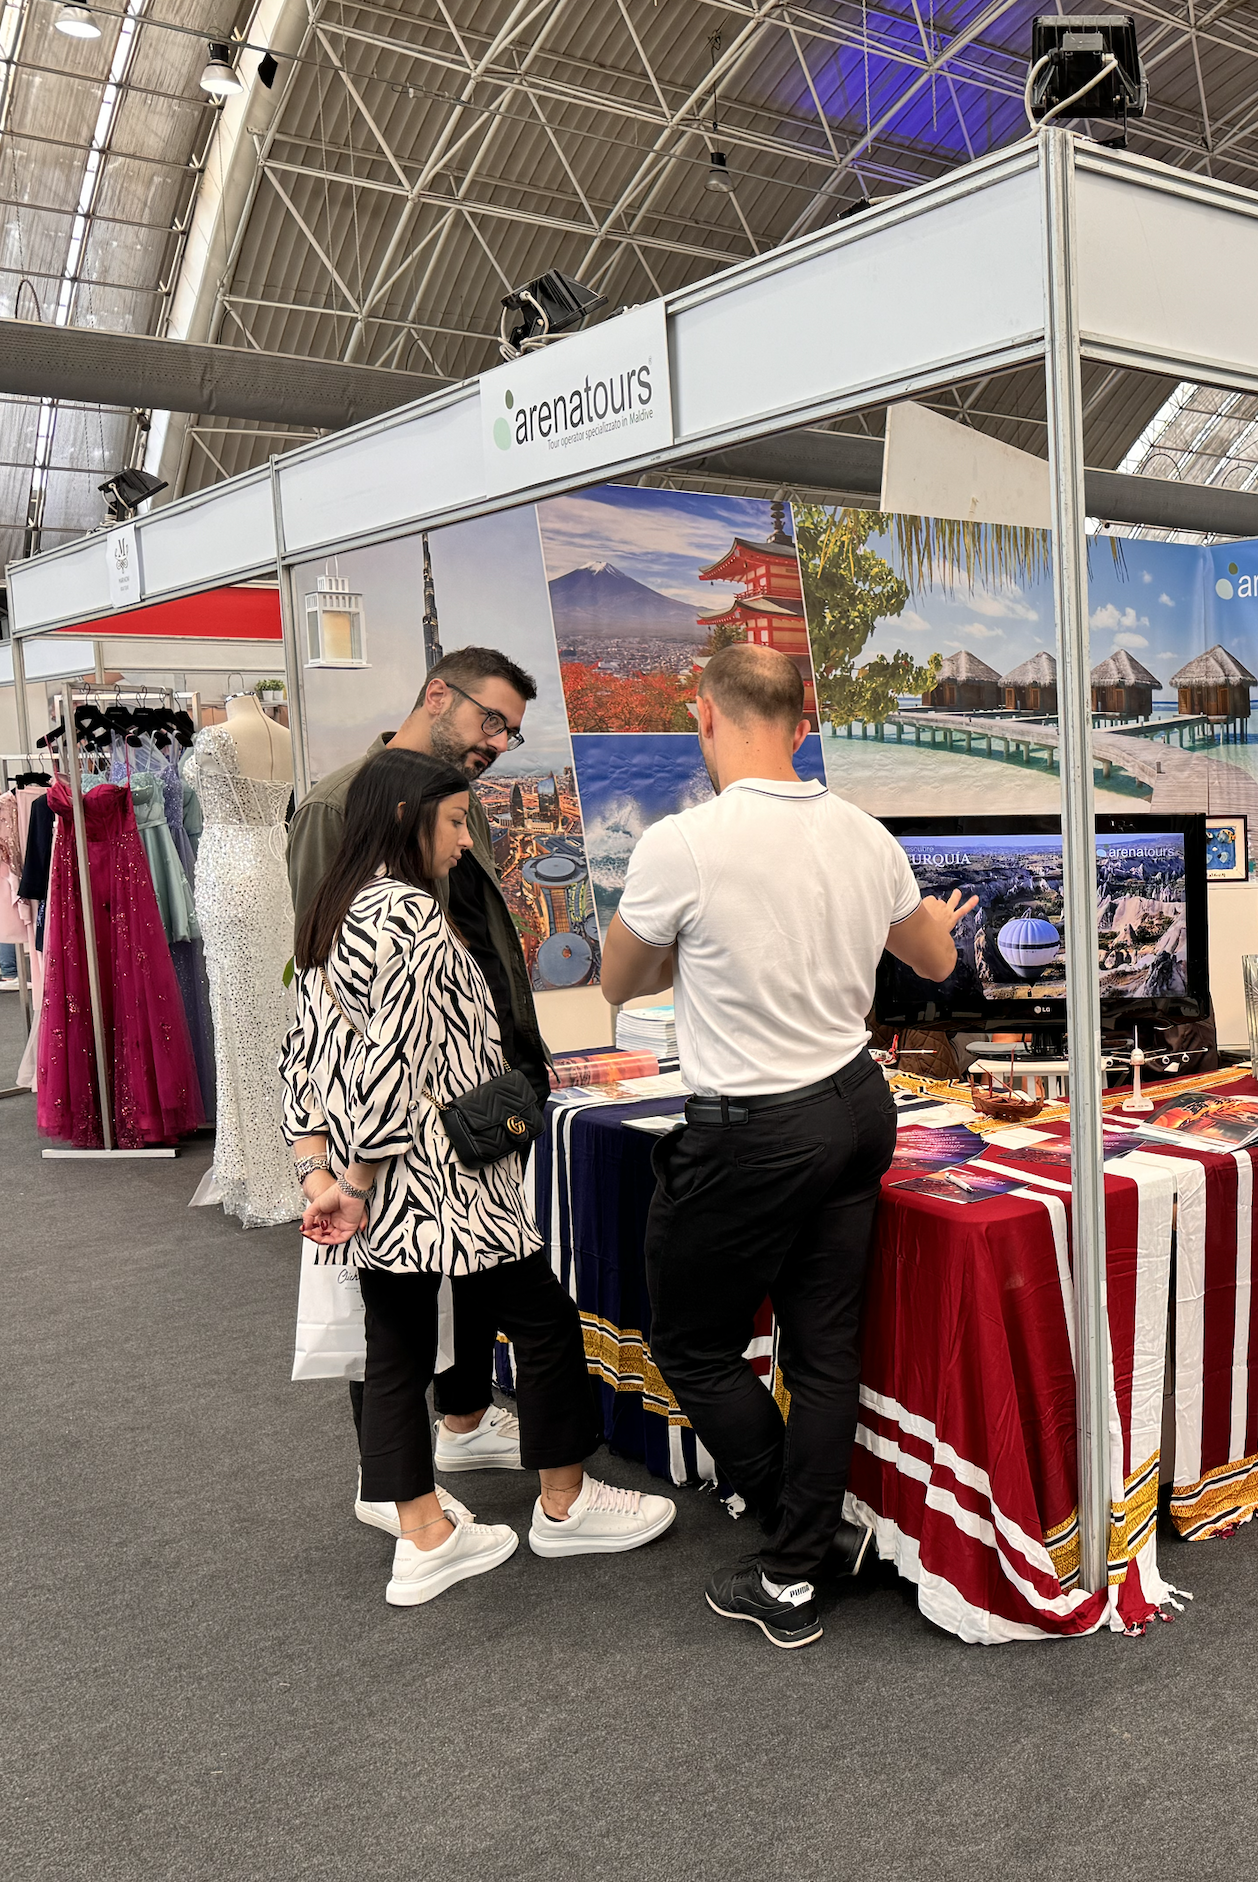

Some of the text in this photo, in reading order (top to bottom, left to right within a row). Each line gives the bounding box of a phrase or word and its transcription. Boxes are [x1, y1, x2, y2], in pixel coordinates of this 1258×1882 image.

[515, 364, 652, 445] arenatours
[547, 408, 653, 450] Tour operator specializzato in Maldive
[905, 844, 935, 853] escubre
[1108, 846, 1175, 858] arenatours
